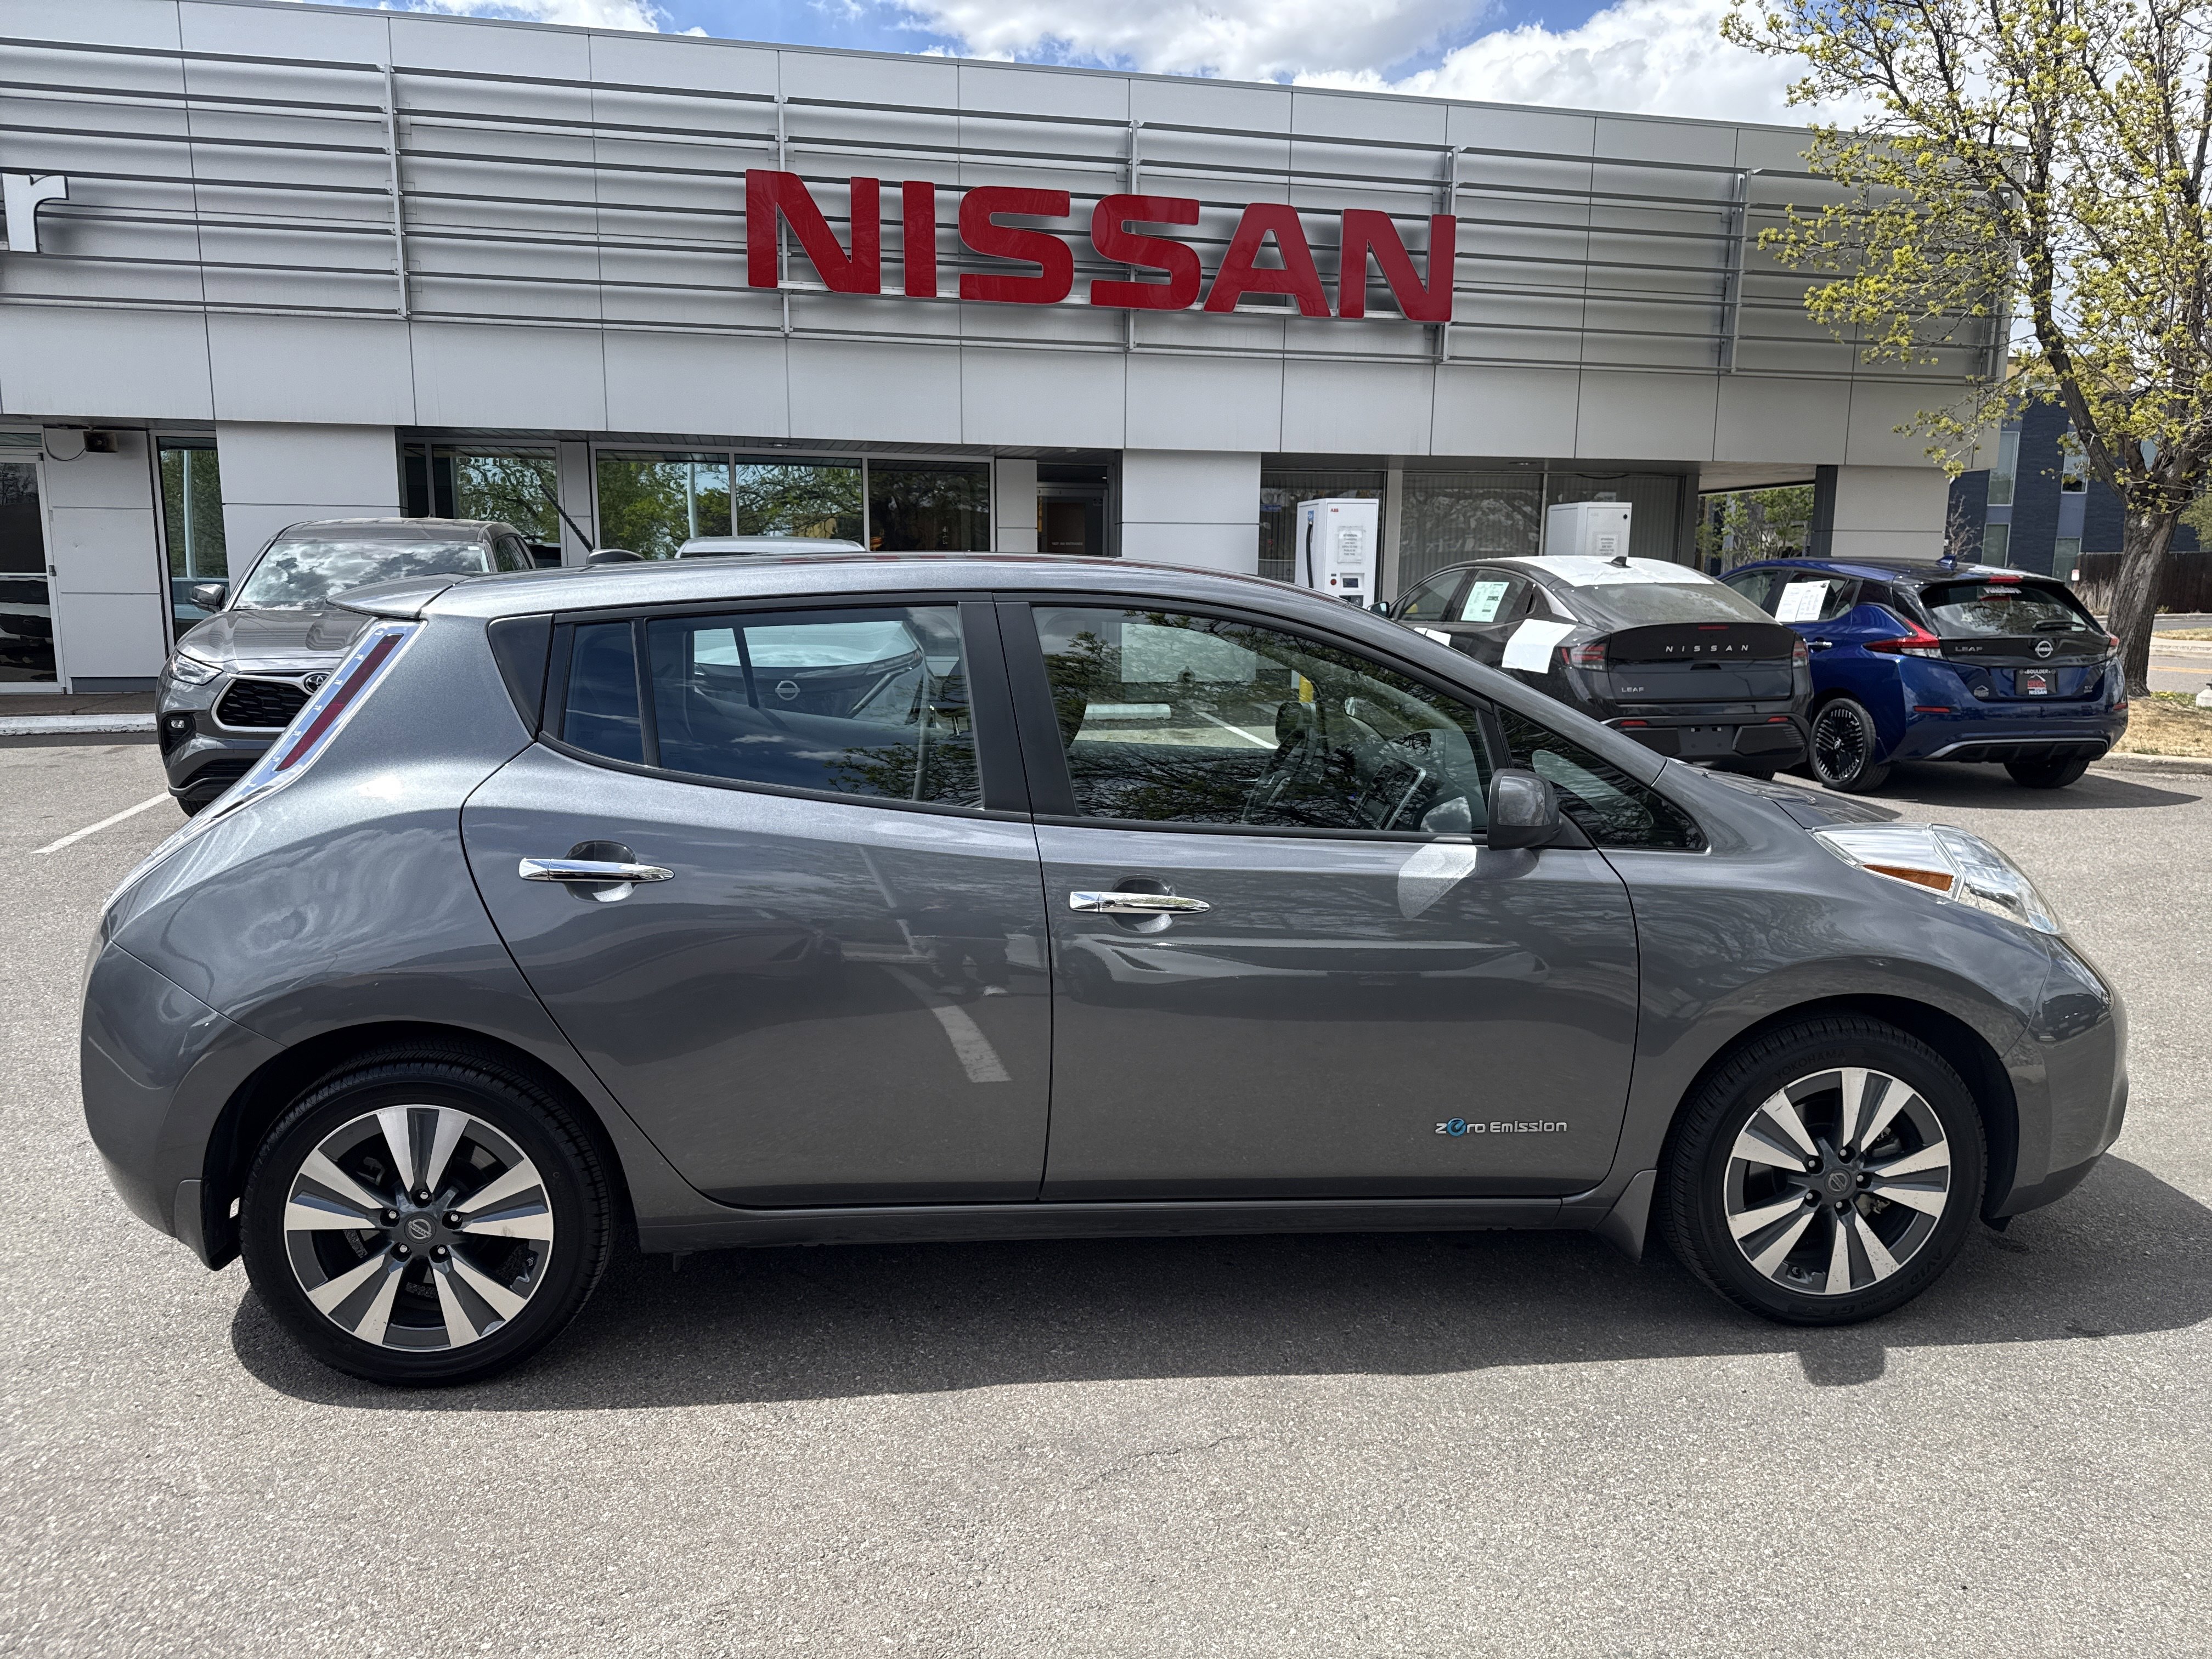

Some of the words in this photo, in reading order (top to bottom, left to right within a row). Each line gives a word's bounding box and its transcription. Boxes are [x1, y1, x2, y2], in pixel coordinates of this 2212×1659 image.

[1, 172, 68, 253] r
[744, 168, 1457, 322] NISSAN
[1774, 1048, 1846, 1079] YOKOHAMA
[1489, 1120, 1567, 1133] Emission
[410, 1224, 430, 1236] NISSAN
